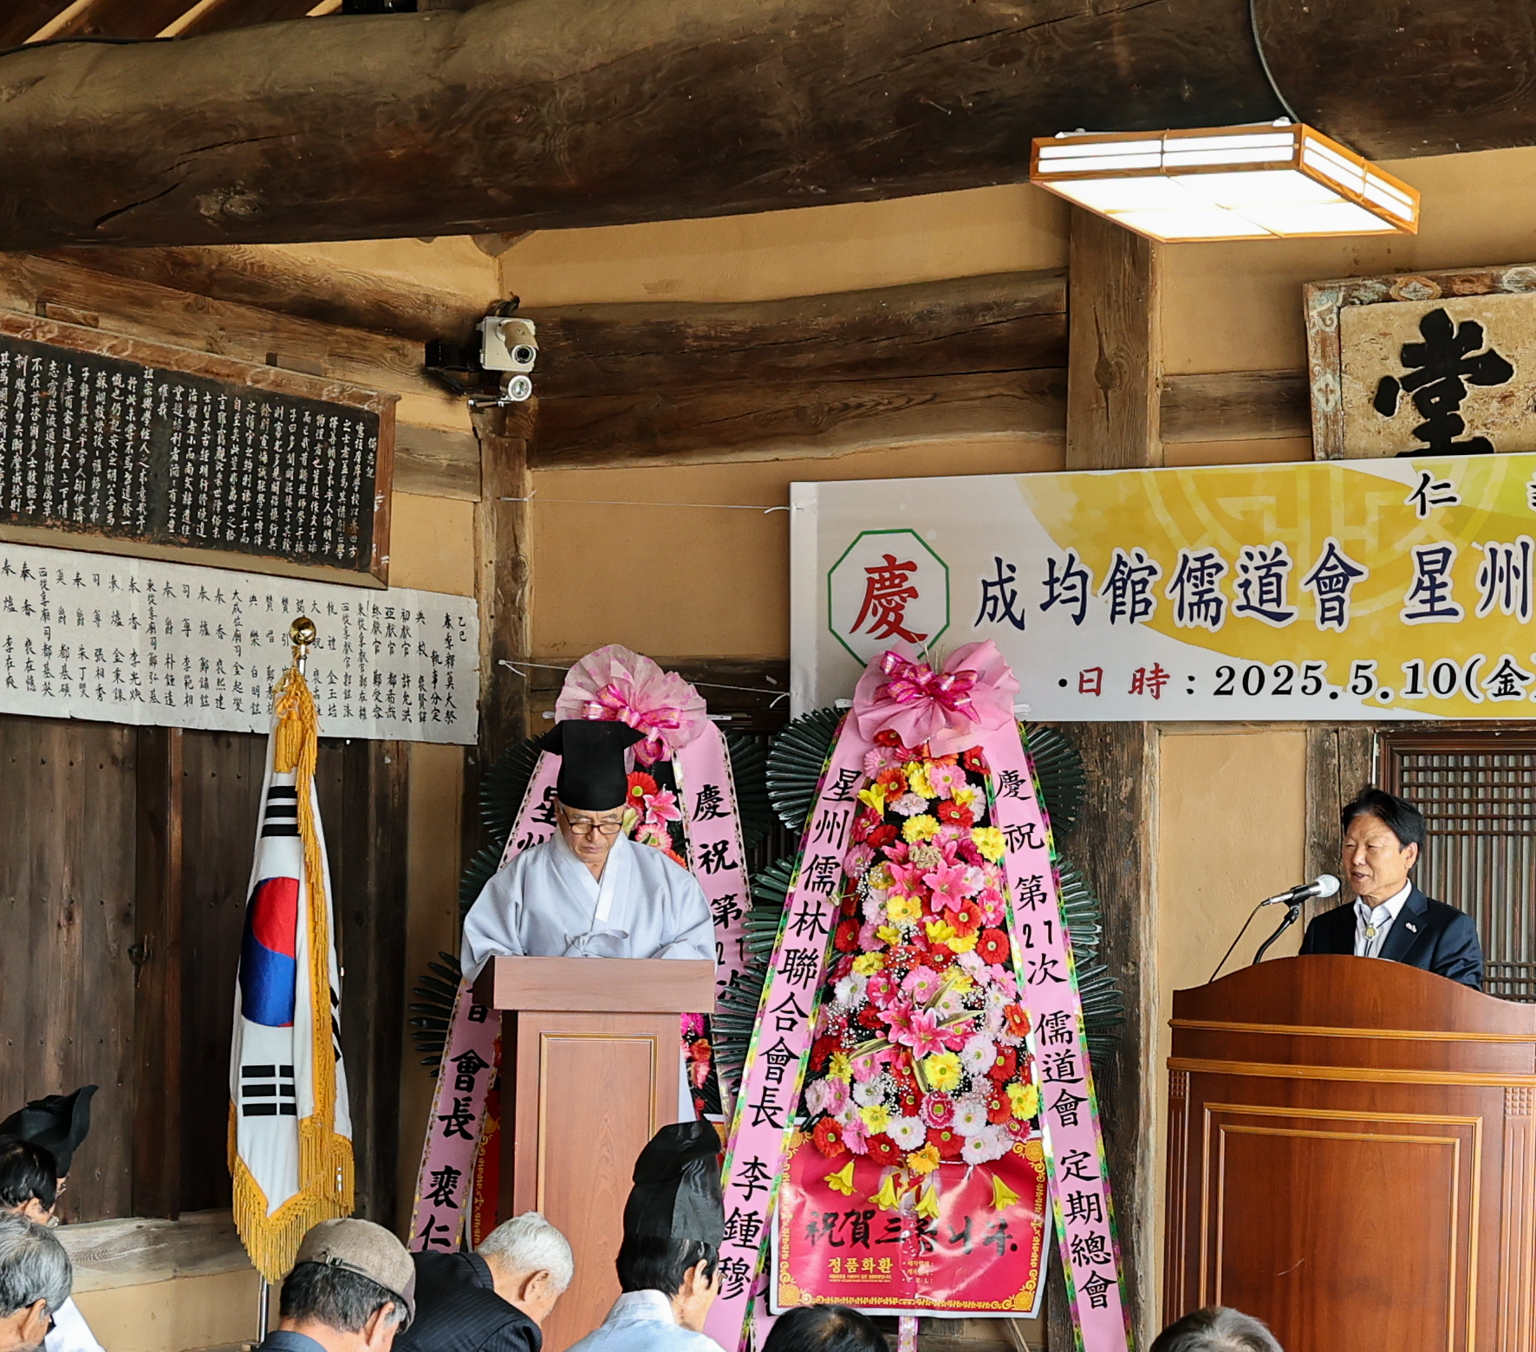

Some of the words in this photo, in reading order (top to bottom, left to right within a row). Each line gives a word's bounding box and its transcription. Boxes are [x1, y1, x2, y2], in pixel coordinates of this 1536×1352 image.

[1408, 471, 1457, 516] 仁
[850, 555, 927, 644] 慶
[974, 541, 1365, 633] 成均館儒道會
[692, 784, 738, 875] 慶祝
[995, 768, 1044, 851] 慶祝
[1035, 1013, 1083, 1129] 儒道會
[1059, 1148, 1117, 1310] 定期總會
[828, 1257, 893, 1274] 정품화환
